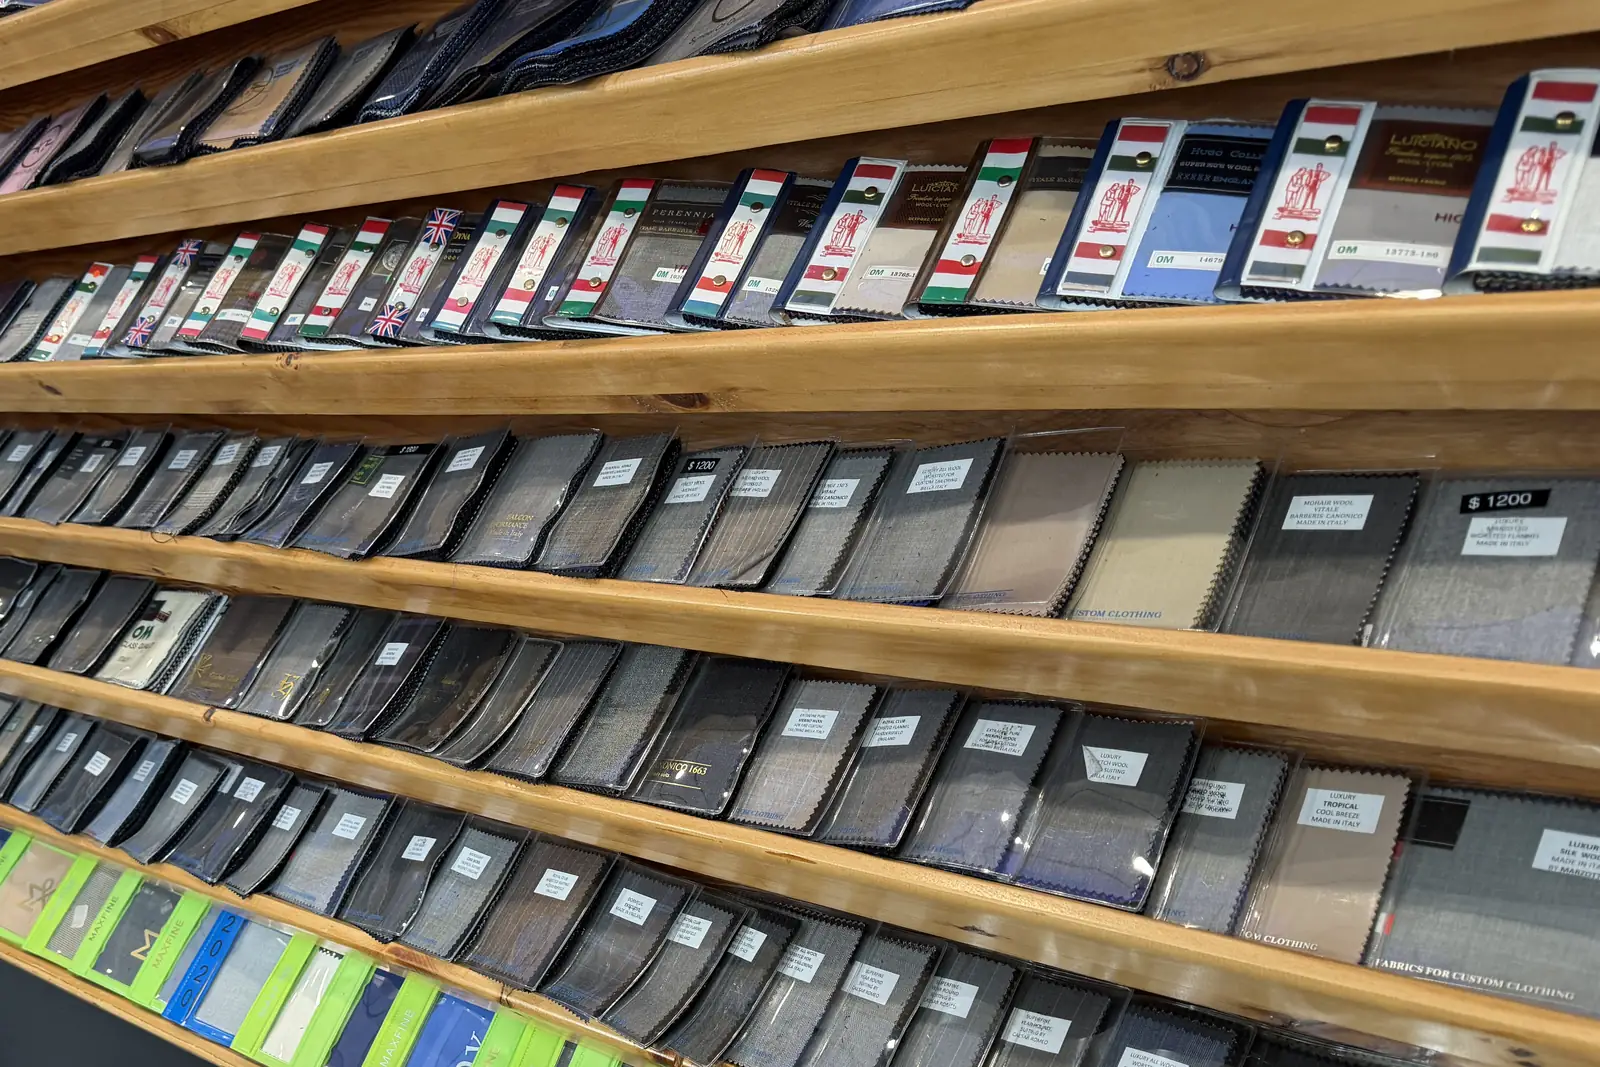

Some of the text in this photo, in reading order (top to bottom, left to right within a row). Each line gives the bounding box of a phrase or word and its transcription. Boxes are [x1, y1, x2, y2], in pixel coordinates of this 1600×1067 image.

[1337, 246, 1358, 254] OM
[1156, 255, 1175, 263] OM
[656, 270, 670, 278] OM
[747, 279, 761, 288] OM
[695, 460, 716, 470] 1200
[1488, 493, 1532, 508] 1200
[1108, 610, 1162, 618] CLOTHING
[688, 766, 708, 776] 1663
[1330, 792, 1356, 800] LUXURY
[1323, 800, 1359, 810] TROPICAL
[1316, 808, 1360, 819] COOL BREEZE
[1552, 856, 1576, 864] MADE
[89, 895, 119, 942] MAXFINE
[152, 919, 184, 969] MAXFINE
[1264, 935, 1318, 950] CLOTHING
[1375, 958, 1576, 1000] FABRICS FOR CUSTOM CLOTHING
[380, 1008, 416, 1067] MAXFINE
